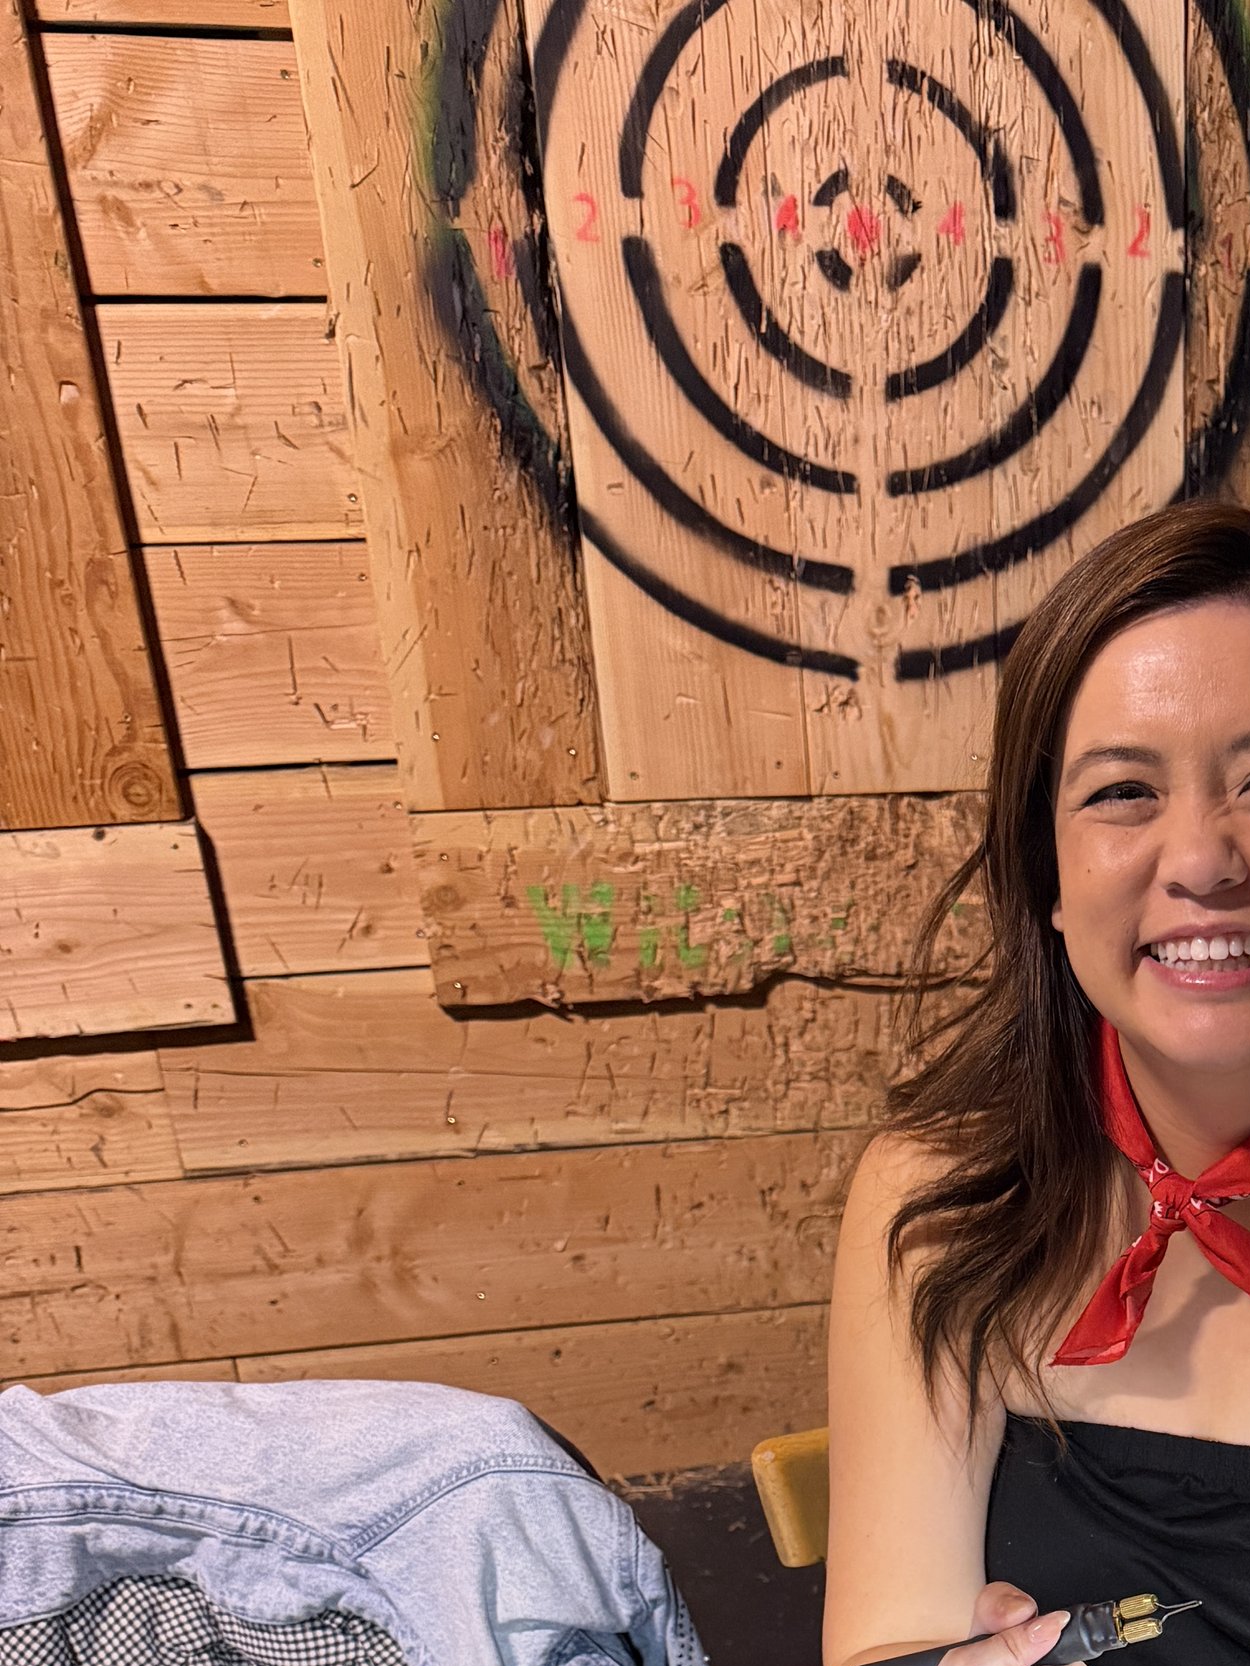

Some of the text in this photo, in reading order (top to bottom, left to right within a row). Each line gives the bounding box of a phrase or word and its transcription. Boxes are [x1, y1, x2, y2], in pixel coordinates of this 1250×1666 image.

[574, 192, 600, 242] 2
[671, 176, 701, 230] 3
[938, 201, 966, 246] 4
[1127, 204, 1151, 258] 2
